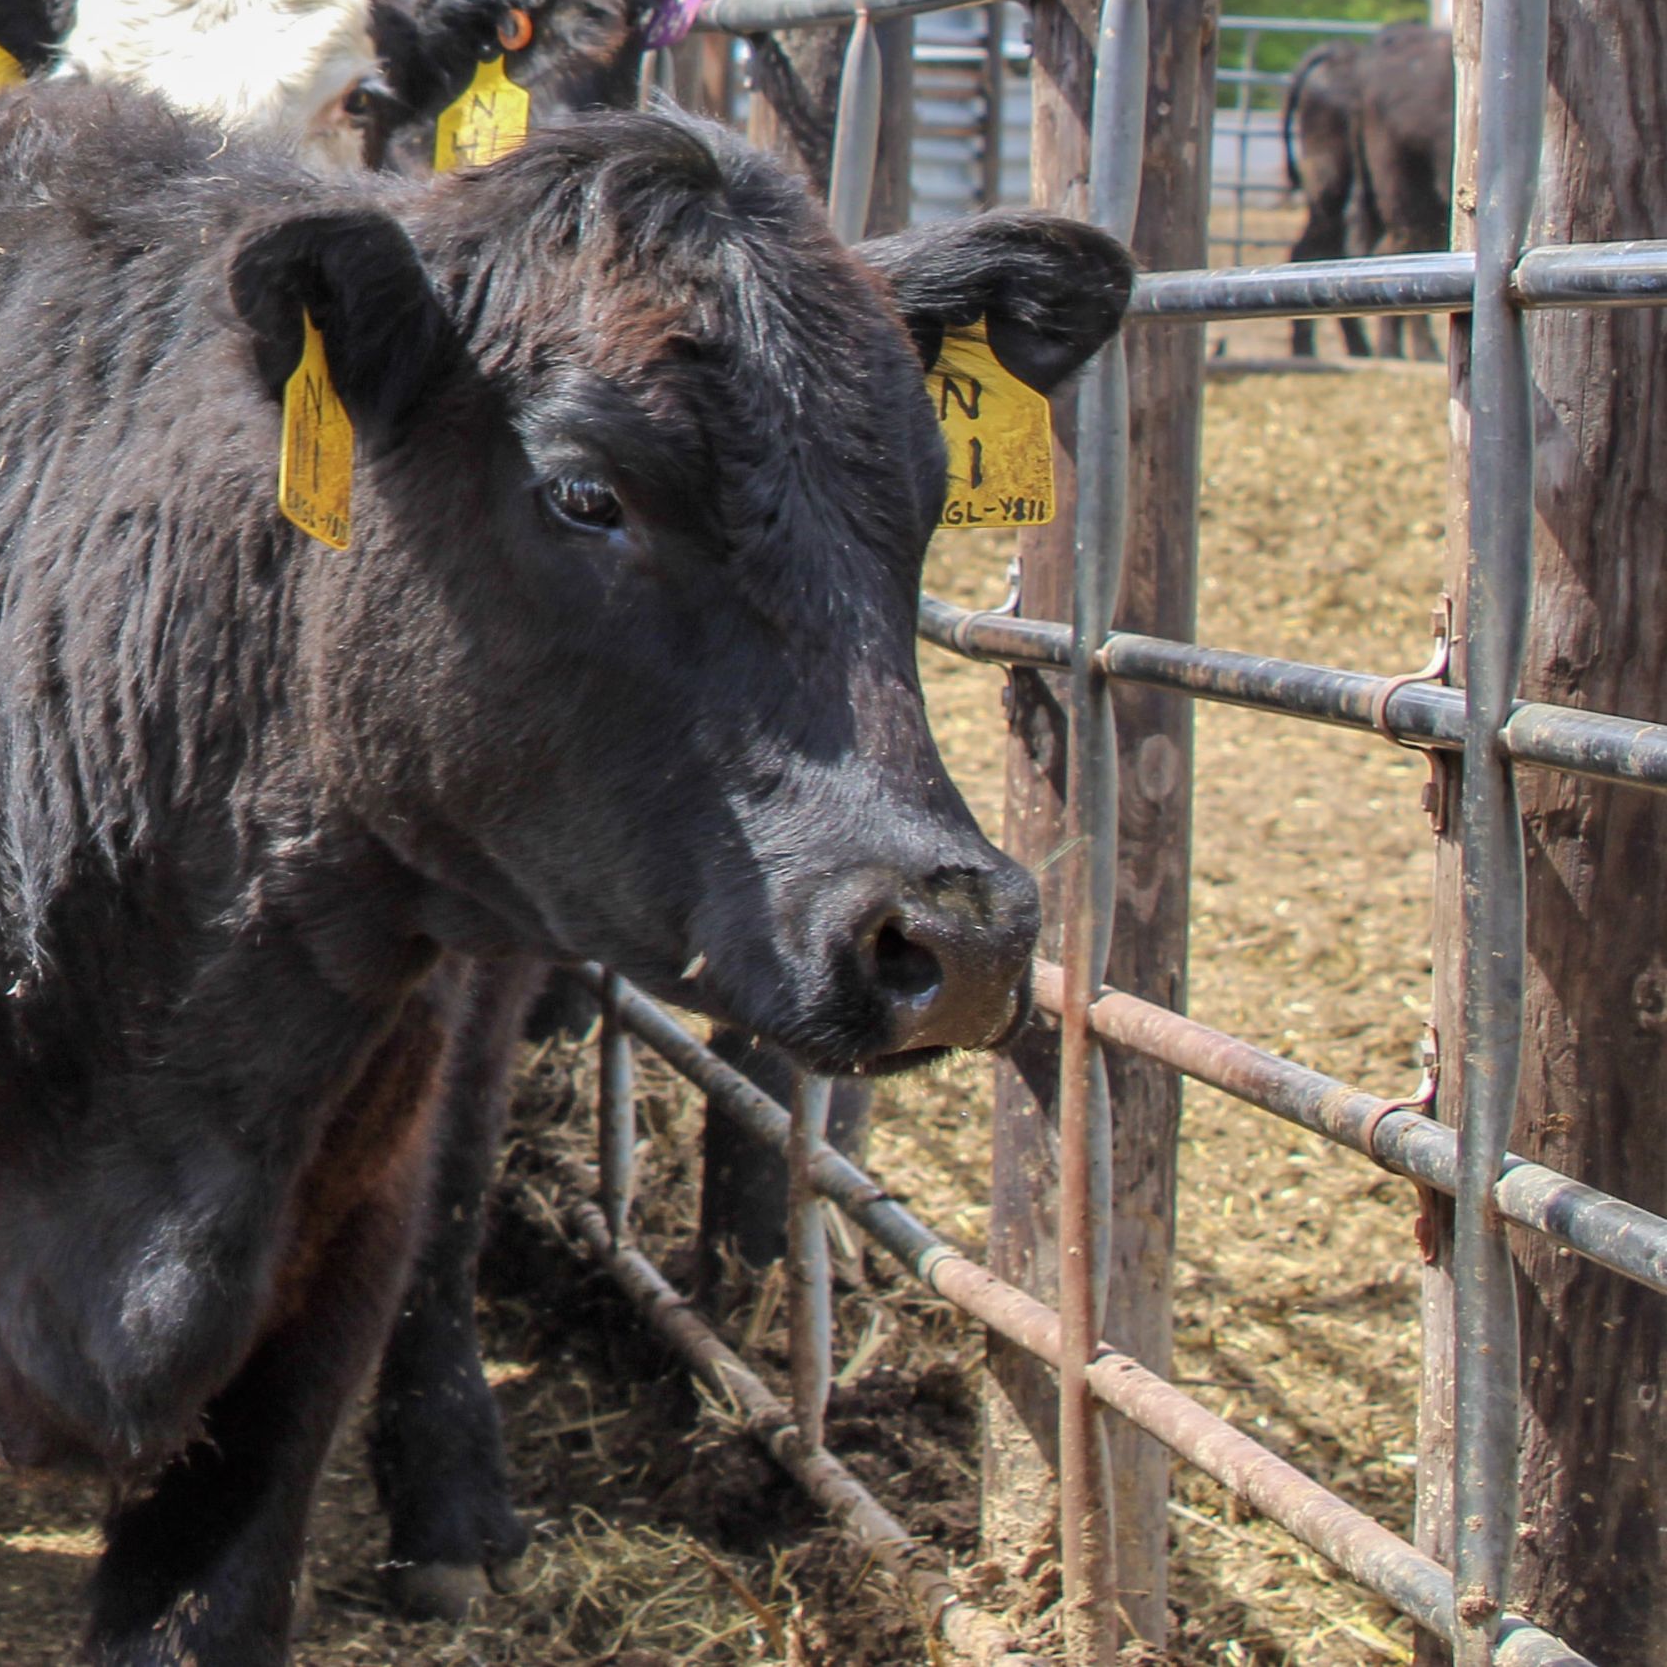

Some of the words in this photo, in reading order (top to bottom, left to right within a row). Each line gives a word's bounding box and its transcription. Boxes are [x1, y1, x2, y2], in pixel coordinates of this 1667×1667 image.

[469, 91, 497, 124] N
[303, 369, 323, 425] N
[940, 376, 982, 421] N
[969, 436, 983, 490] 1
[938, 497, 1045, 525] GL-Y811
